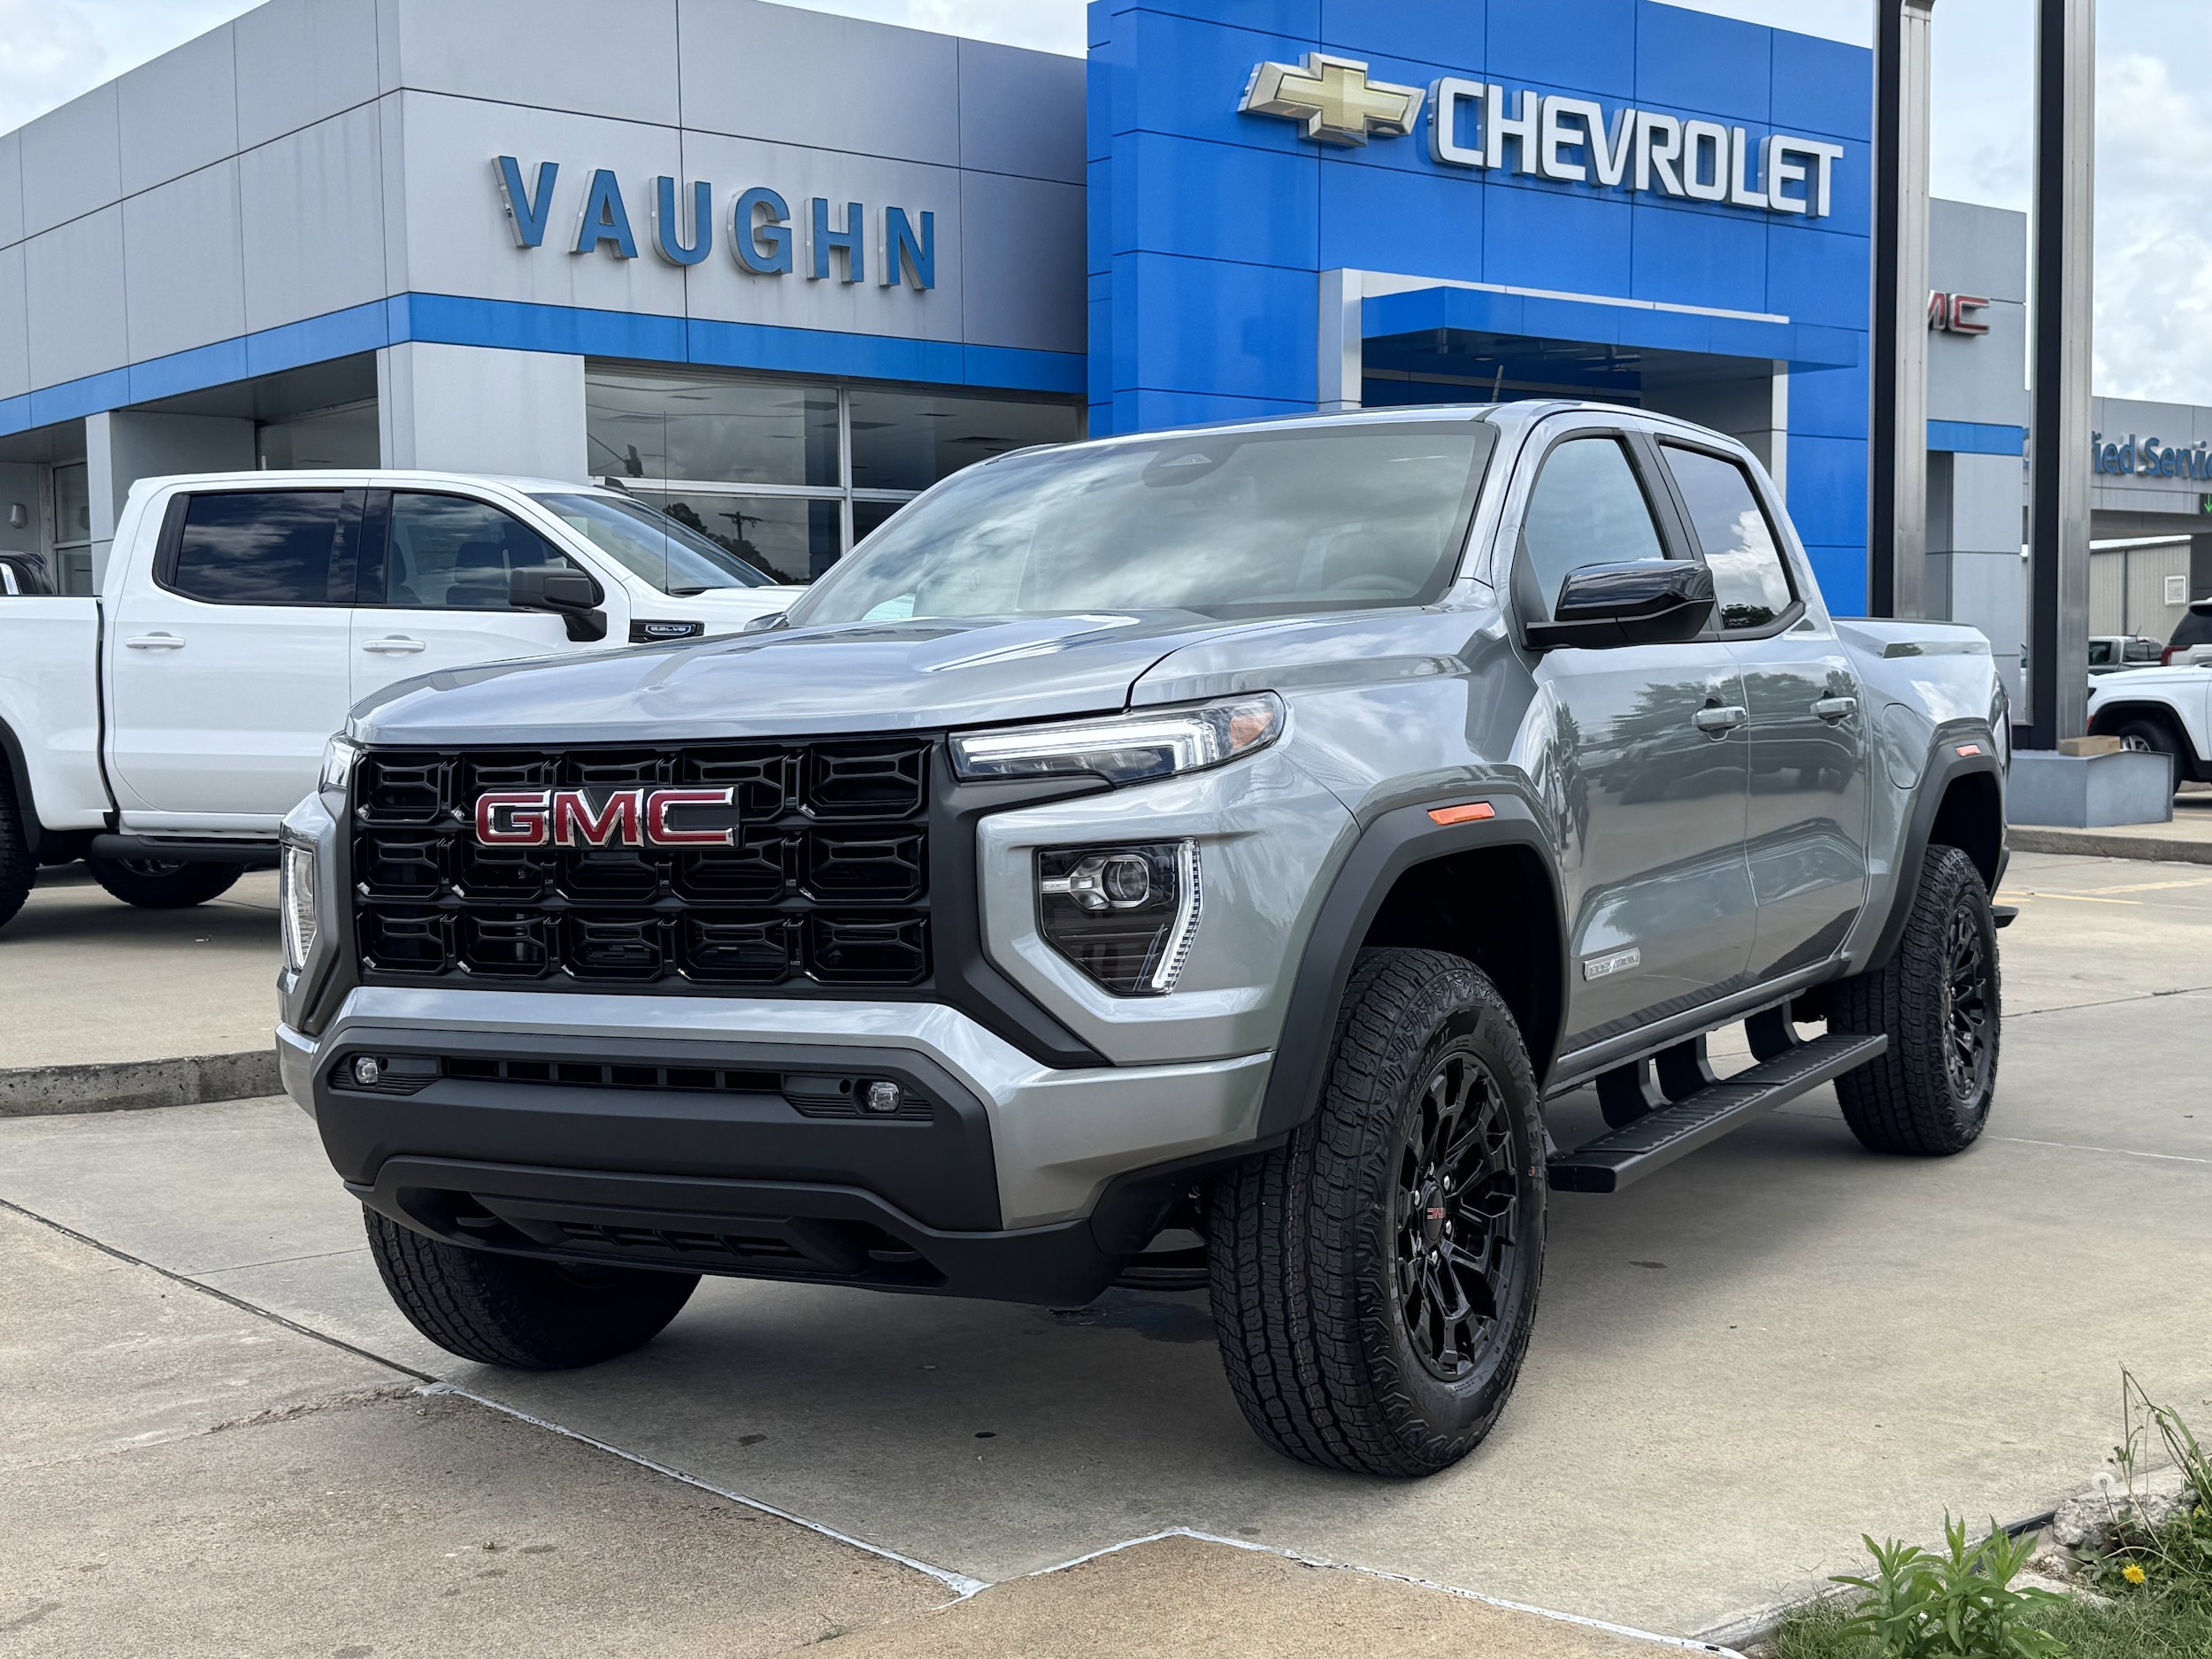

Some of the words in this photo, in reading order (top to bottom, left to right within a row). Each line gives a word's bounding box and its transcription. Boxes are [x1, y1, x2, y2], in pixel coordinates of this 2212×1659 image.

[1428, 76, 1844, 219] CHEVROLET
[492, 155, 935, 290] VAUGHN
[474, 787, 734, 849] GMC
